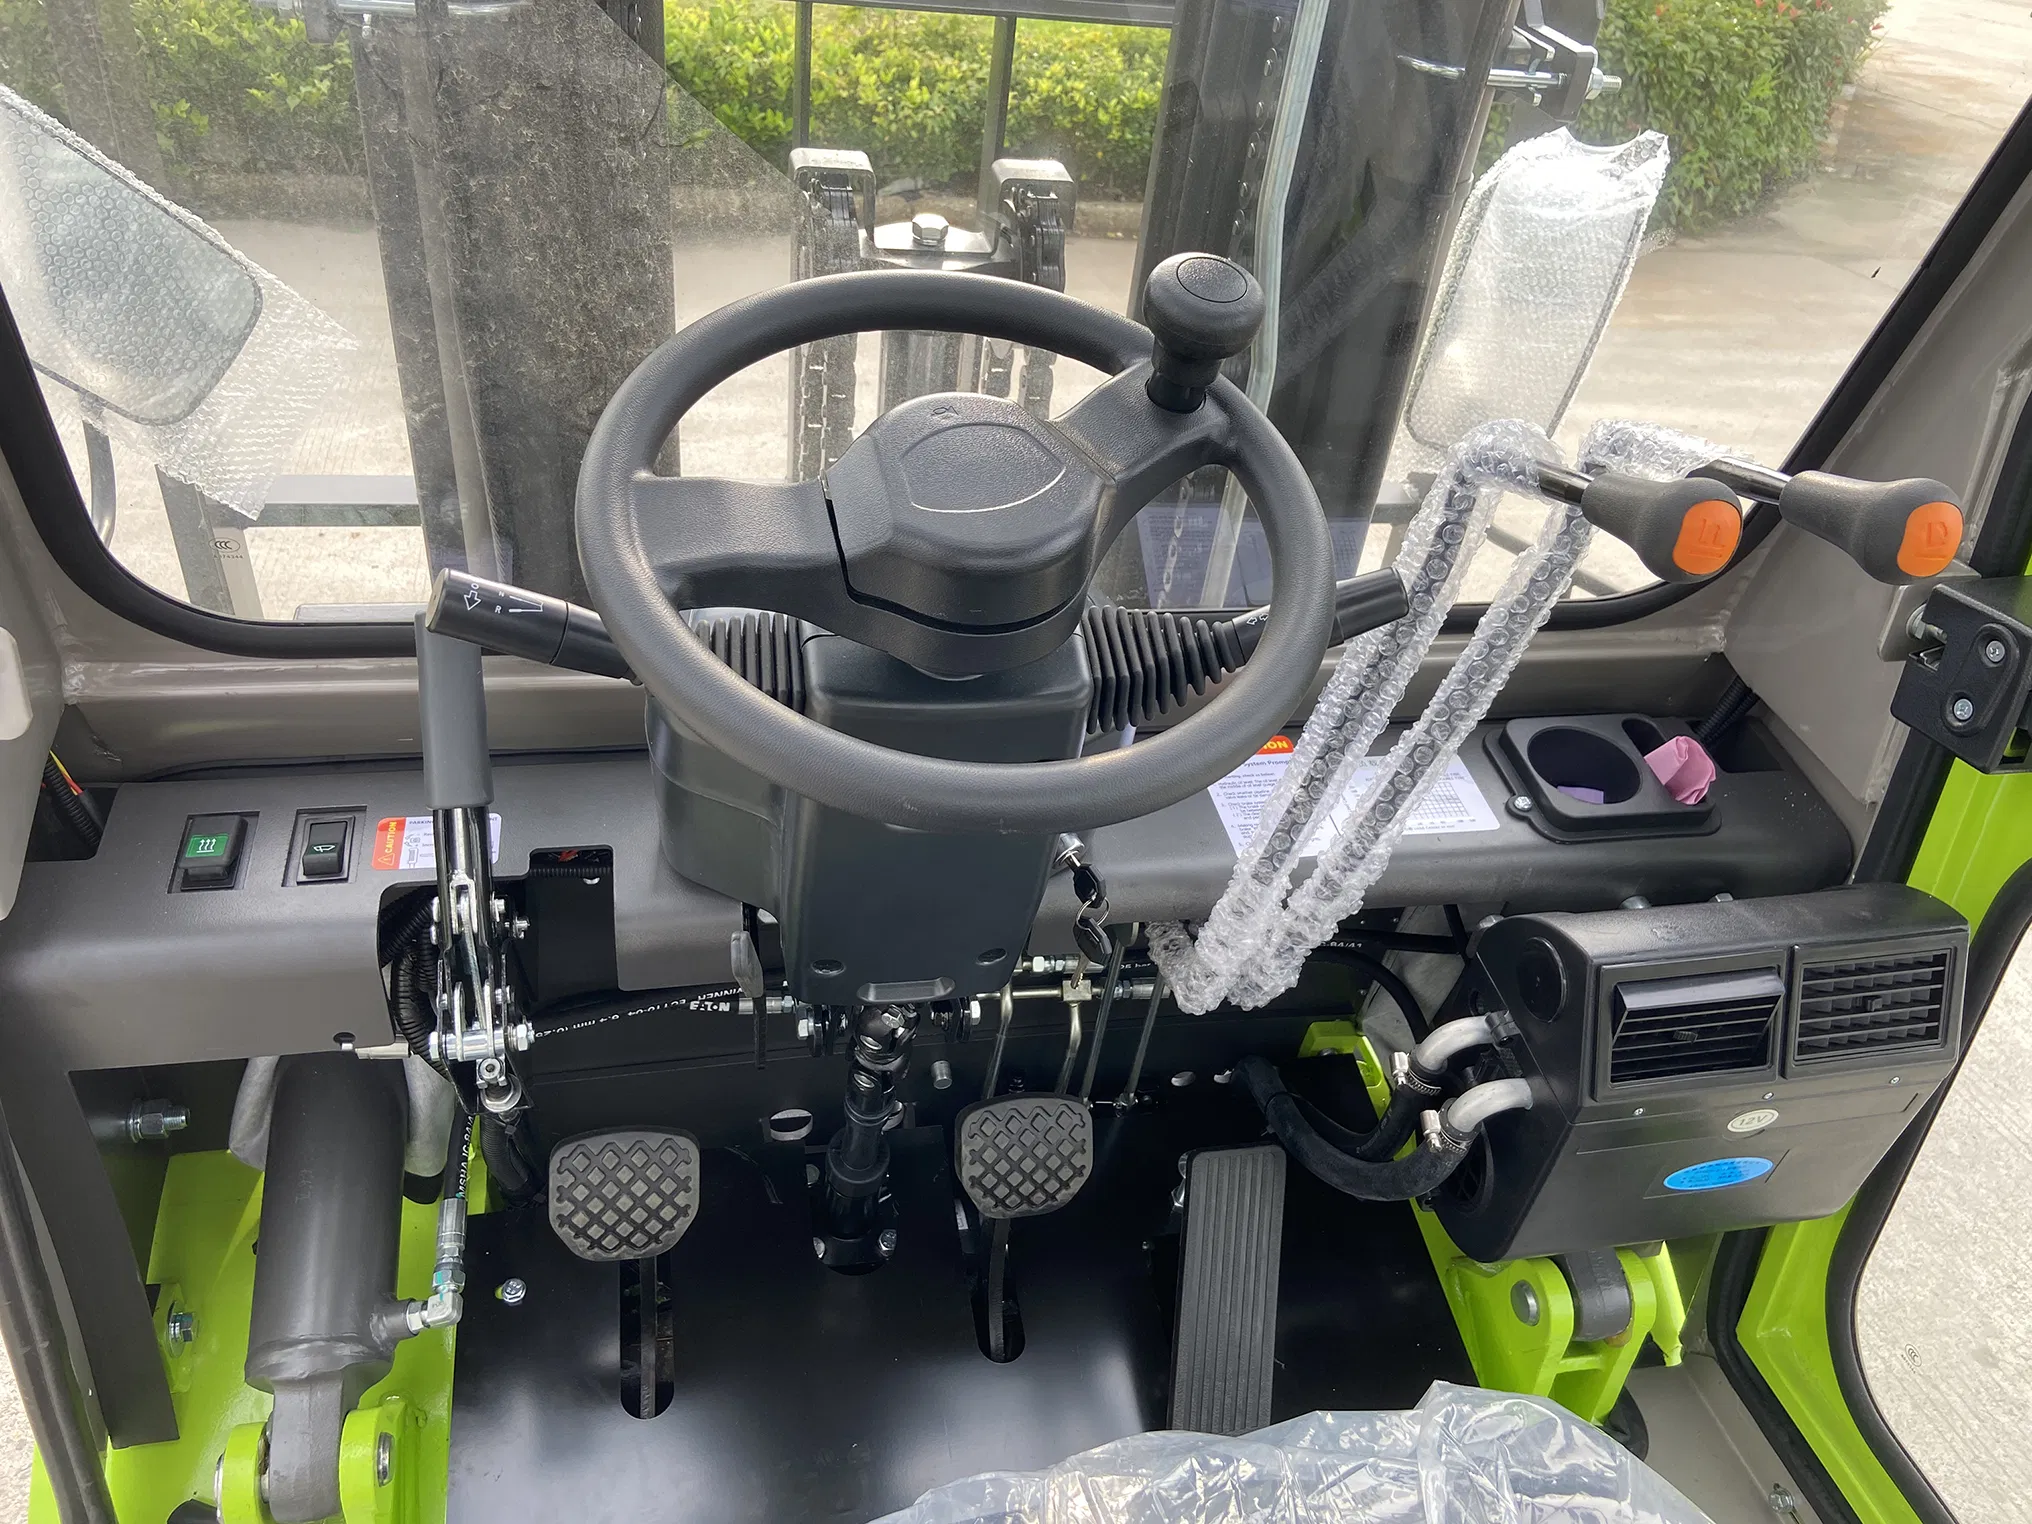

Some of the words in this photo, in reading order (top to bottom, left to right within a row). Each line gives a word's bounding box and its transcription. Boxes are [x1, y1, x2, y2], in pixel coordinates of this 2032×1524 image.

[494, 604, 502, 614] R
[384, 821, 397, 853] CAUTION
[1739, 1114, 1768, 1126] 12V
